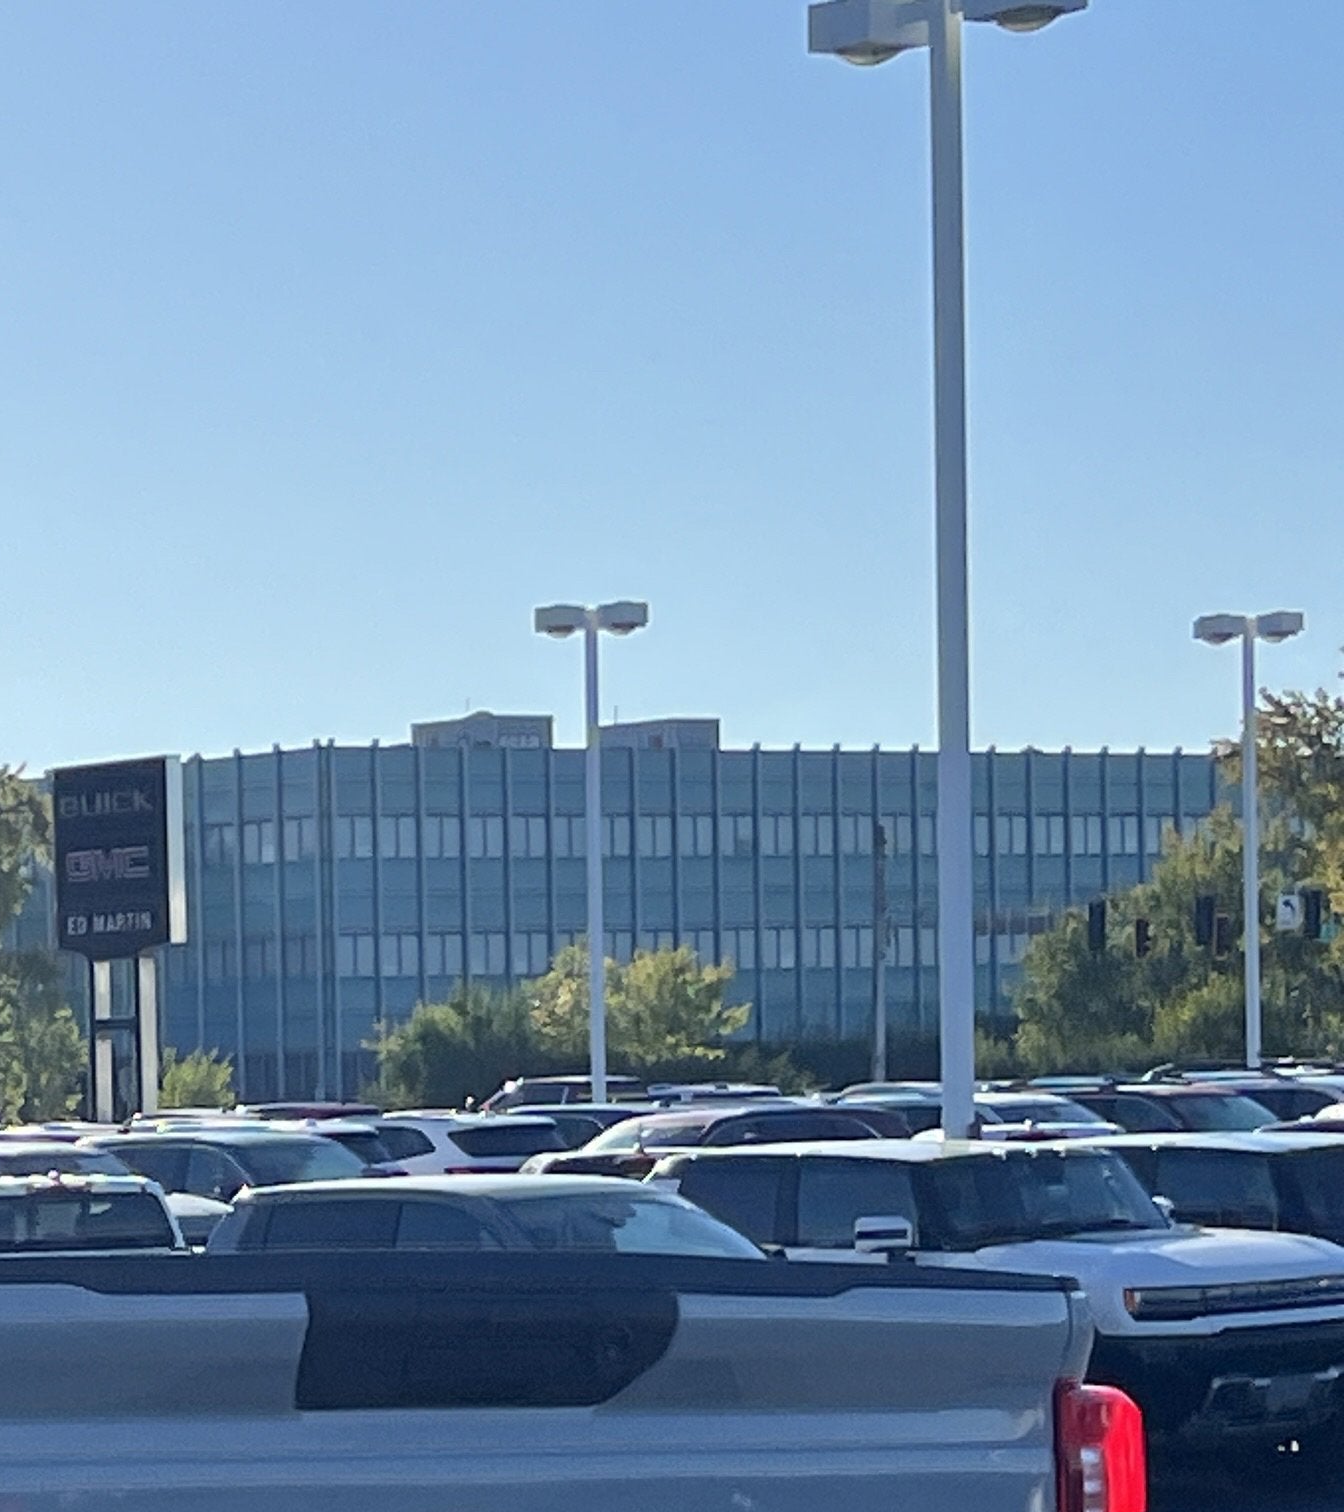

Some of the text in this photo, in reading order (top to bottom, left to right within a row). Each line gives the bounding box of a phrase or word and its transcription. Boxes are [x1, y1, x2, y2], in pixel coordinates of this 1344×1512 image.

[59, 789, 153, 818] BUICK
[65, 844, 151, 882] GMC
[67, 911, 153, 936] ED MARTIN
